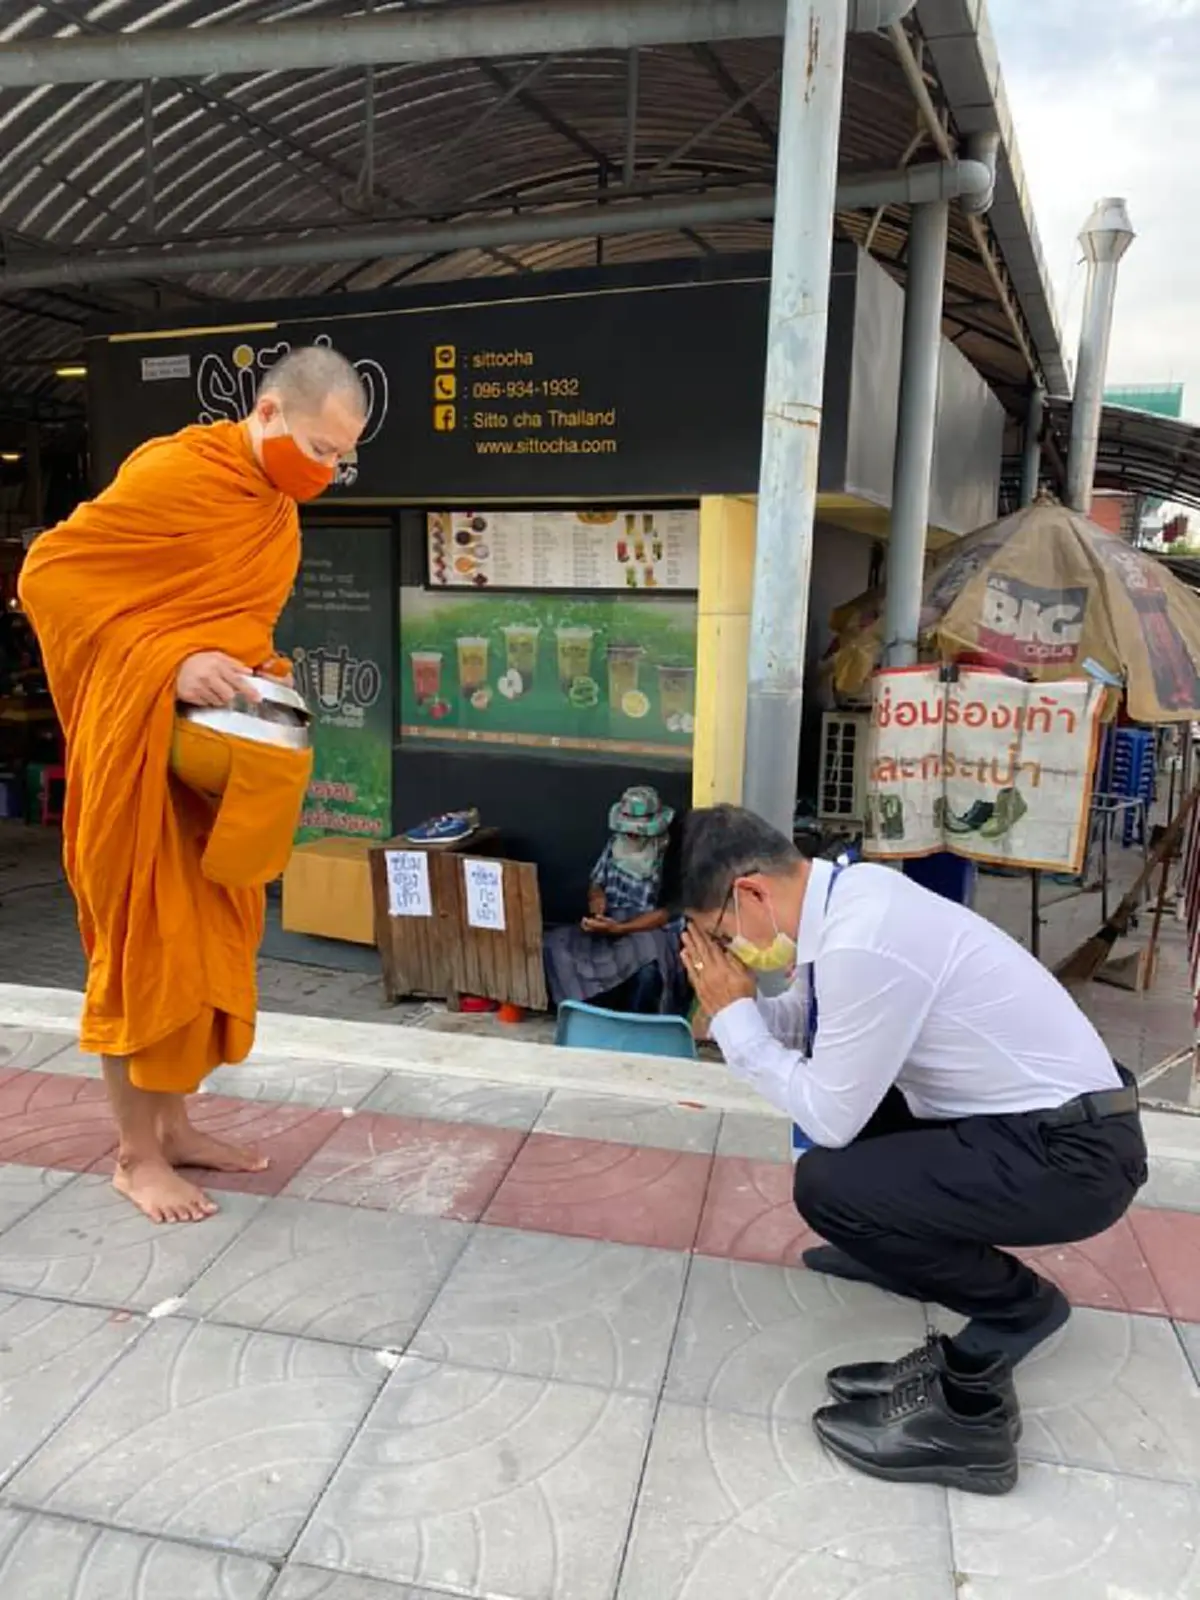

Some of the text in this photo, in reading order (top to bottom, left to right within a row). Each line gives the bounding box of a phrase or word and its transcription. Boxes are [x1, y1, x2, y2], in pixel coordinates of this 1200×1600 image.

[473, 349, 534, 367] sittocha
[473, 378, 580, 398] 096-934-1932
[473, 408, 616, 429] Sitto cha Thailand
[475, 438, 616, 454] www.sittocha.com
[984, 590, 1083, 645] BIG
